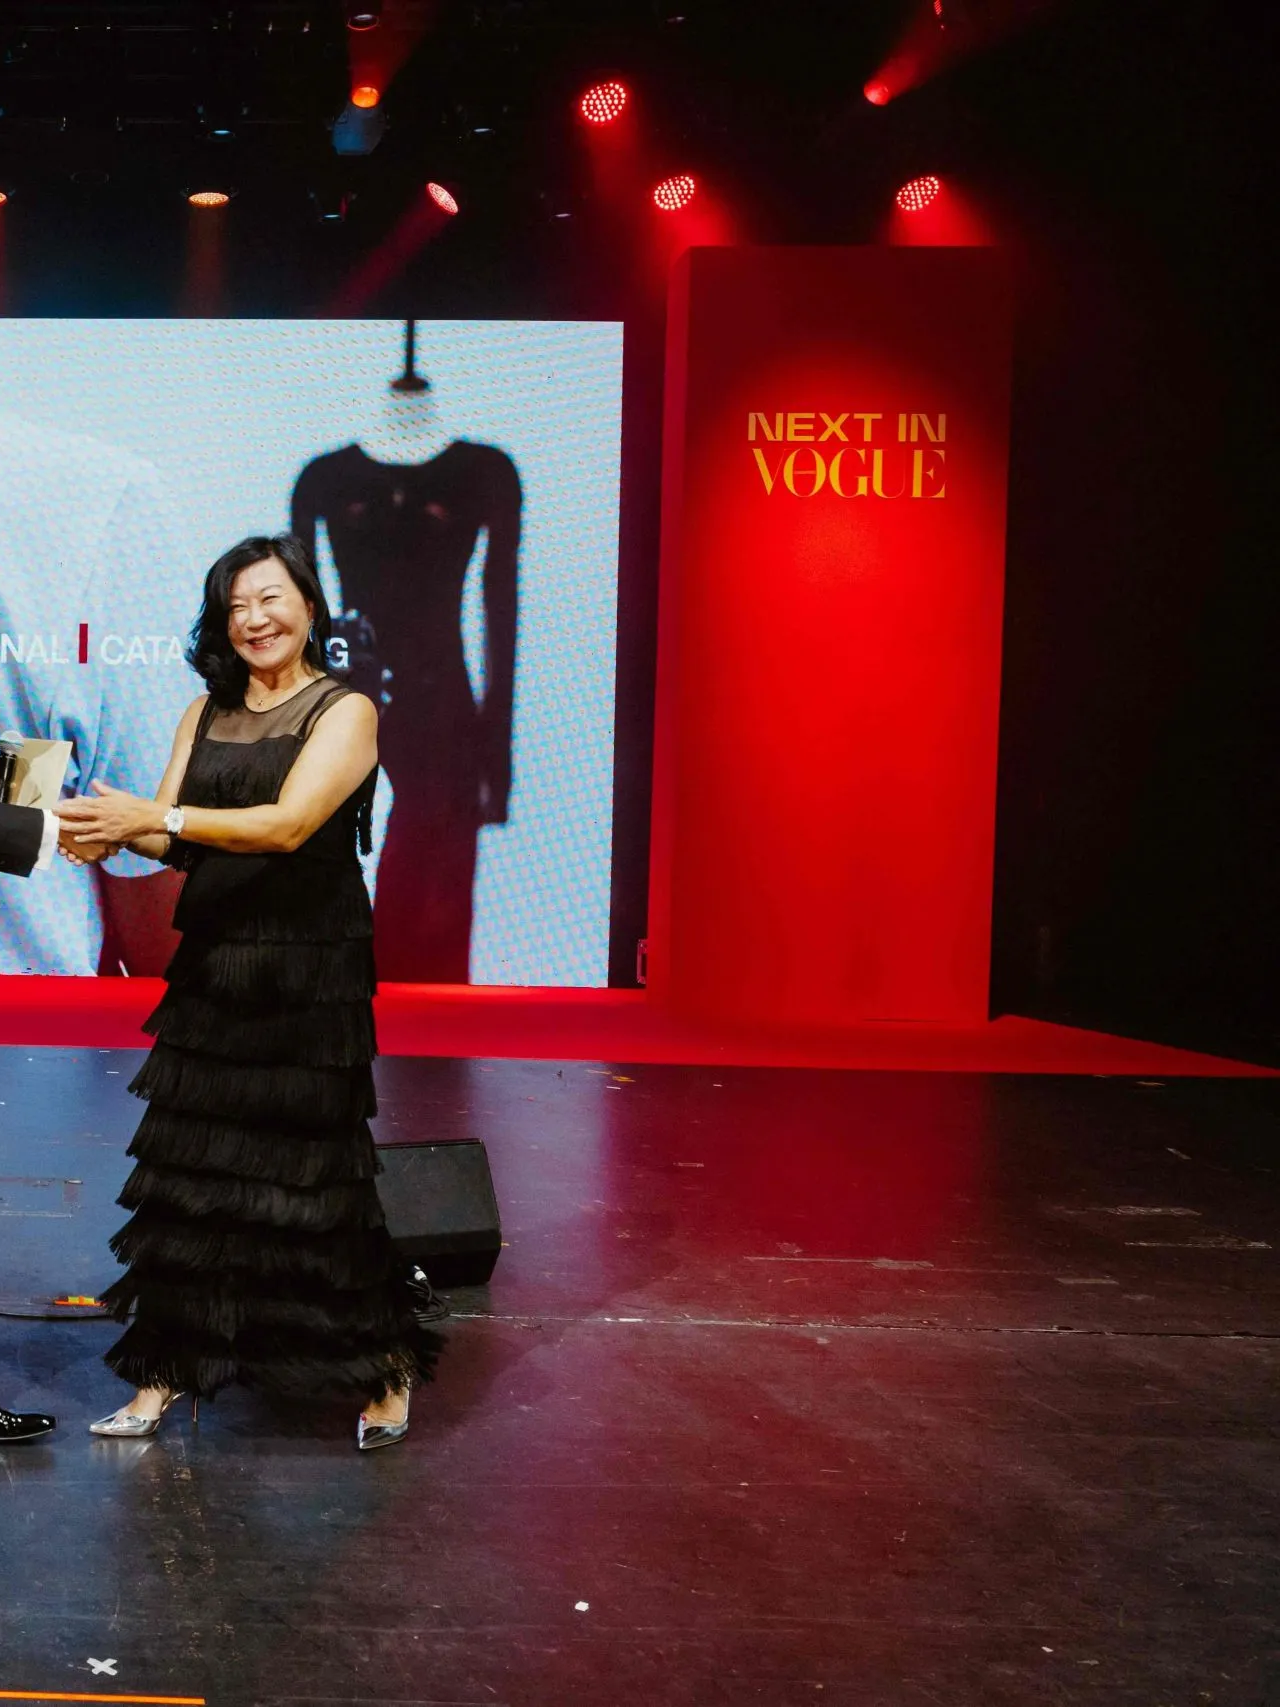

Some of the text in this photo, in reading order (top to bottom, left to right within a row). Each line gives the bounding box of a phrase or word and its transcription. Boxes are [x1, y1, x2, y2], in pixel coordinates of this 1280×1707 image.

[747, 412, 947, 442] NEXT IN
[751, 447, 947, 498] VOGUE
